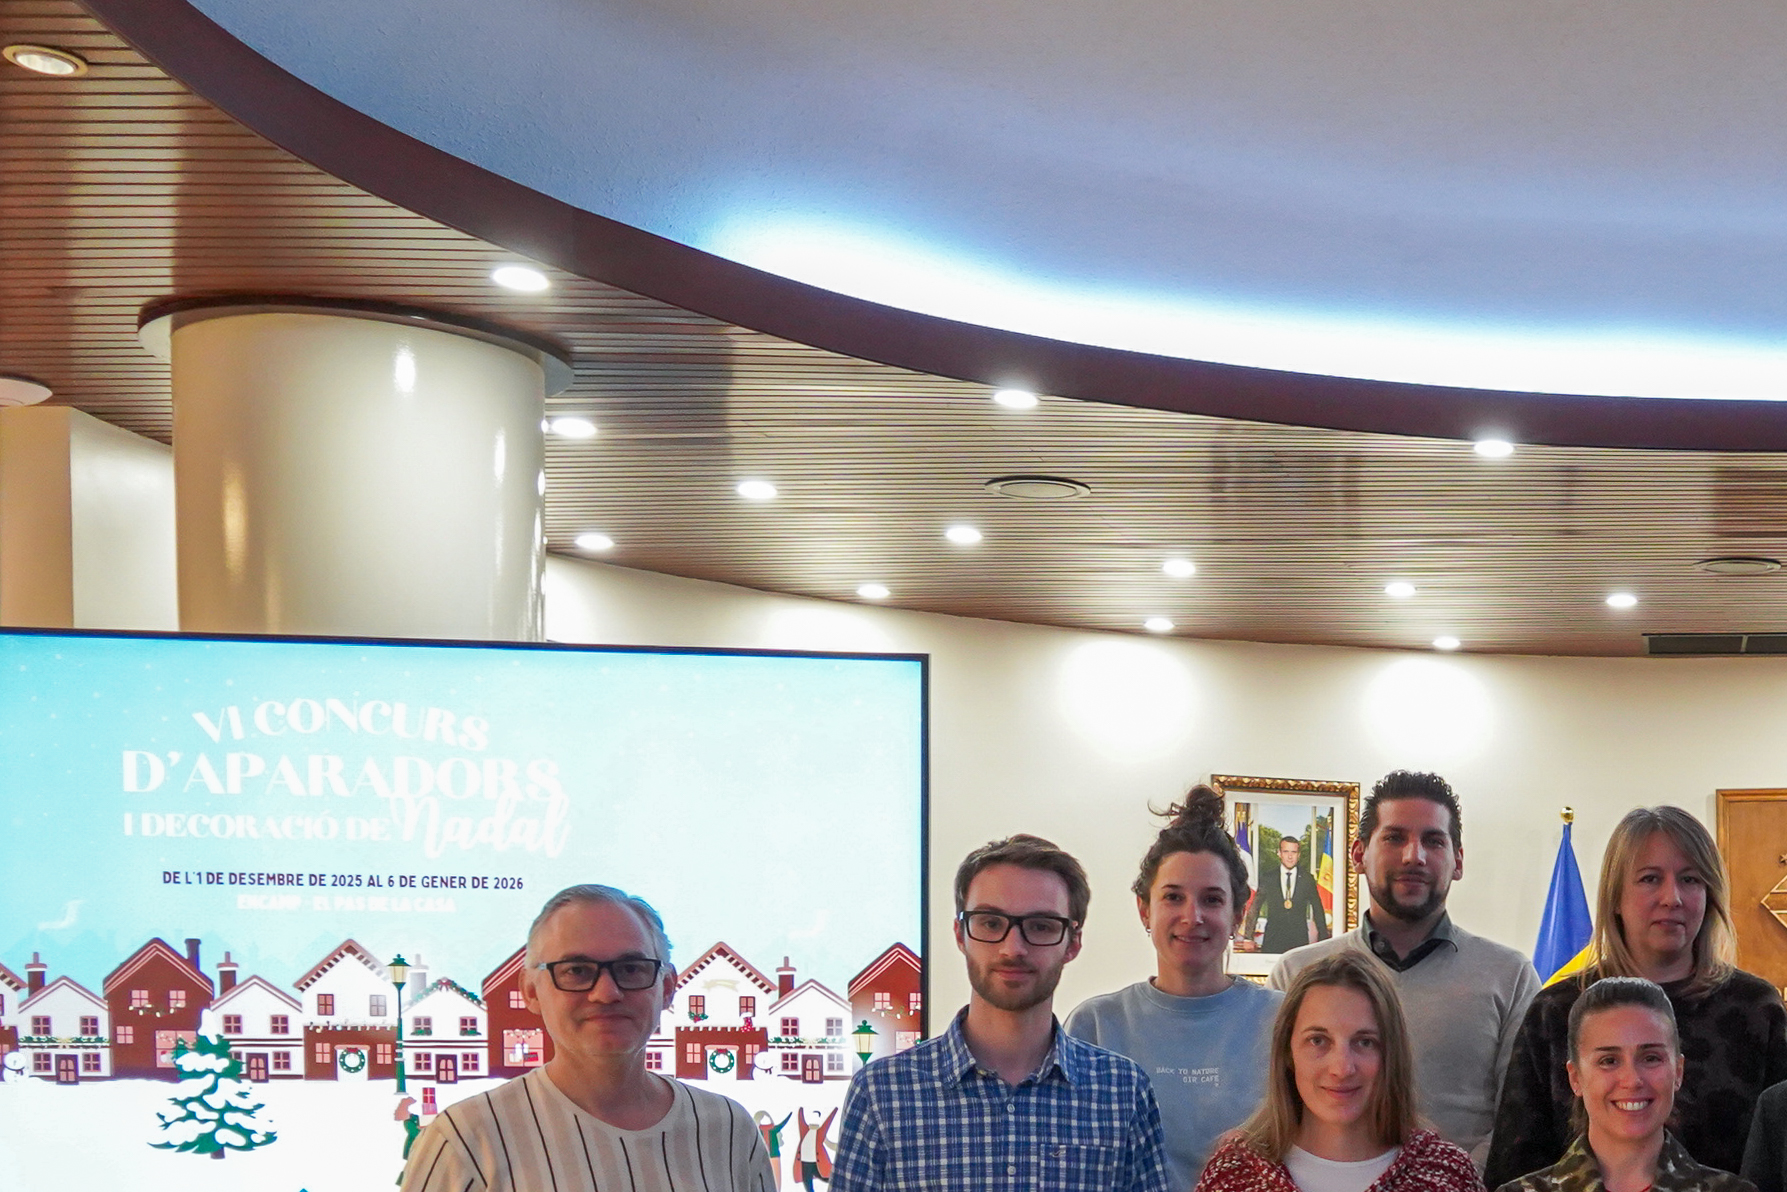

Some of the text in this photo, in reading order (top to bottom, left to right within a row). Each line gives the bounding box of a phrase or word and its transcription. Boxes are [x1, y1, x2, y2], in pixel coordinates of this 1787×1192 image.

[192, 698, 490, 751] VI CONCURS
[141, 809, 338, 840] DECORACIÓ
[346, 817, 392, 841] DE
[387, 789, 572, 858] Nadal
[163, 871, 181, 884] DE
[206, 872, 224, 885] DE
[229, 872, 304, 886] DESEMBRE
[308, 873, 327, 887] DE
[331, 874, 362, 887] 2025
[367, 875, 383, 888] AL
[387, 875, 395, 888] 6
[400, 875, 417, 888] DE
[421, 875, 467, 889] GENER
[471, 876, 489, 889] DE
[494, 876, 524, 890] 2026
[1192, 1067, 1219, 1075] NATURE
